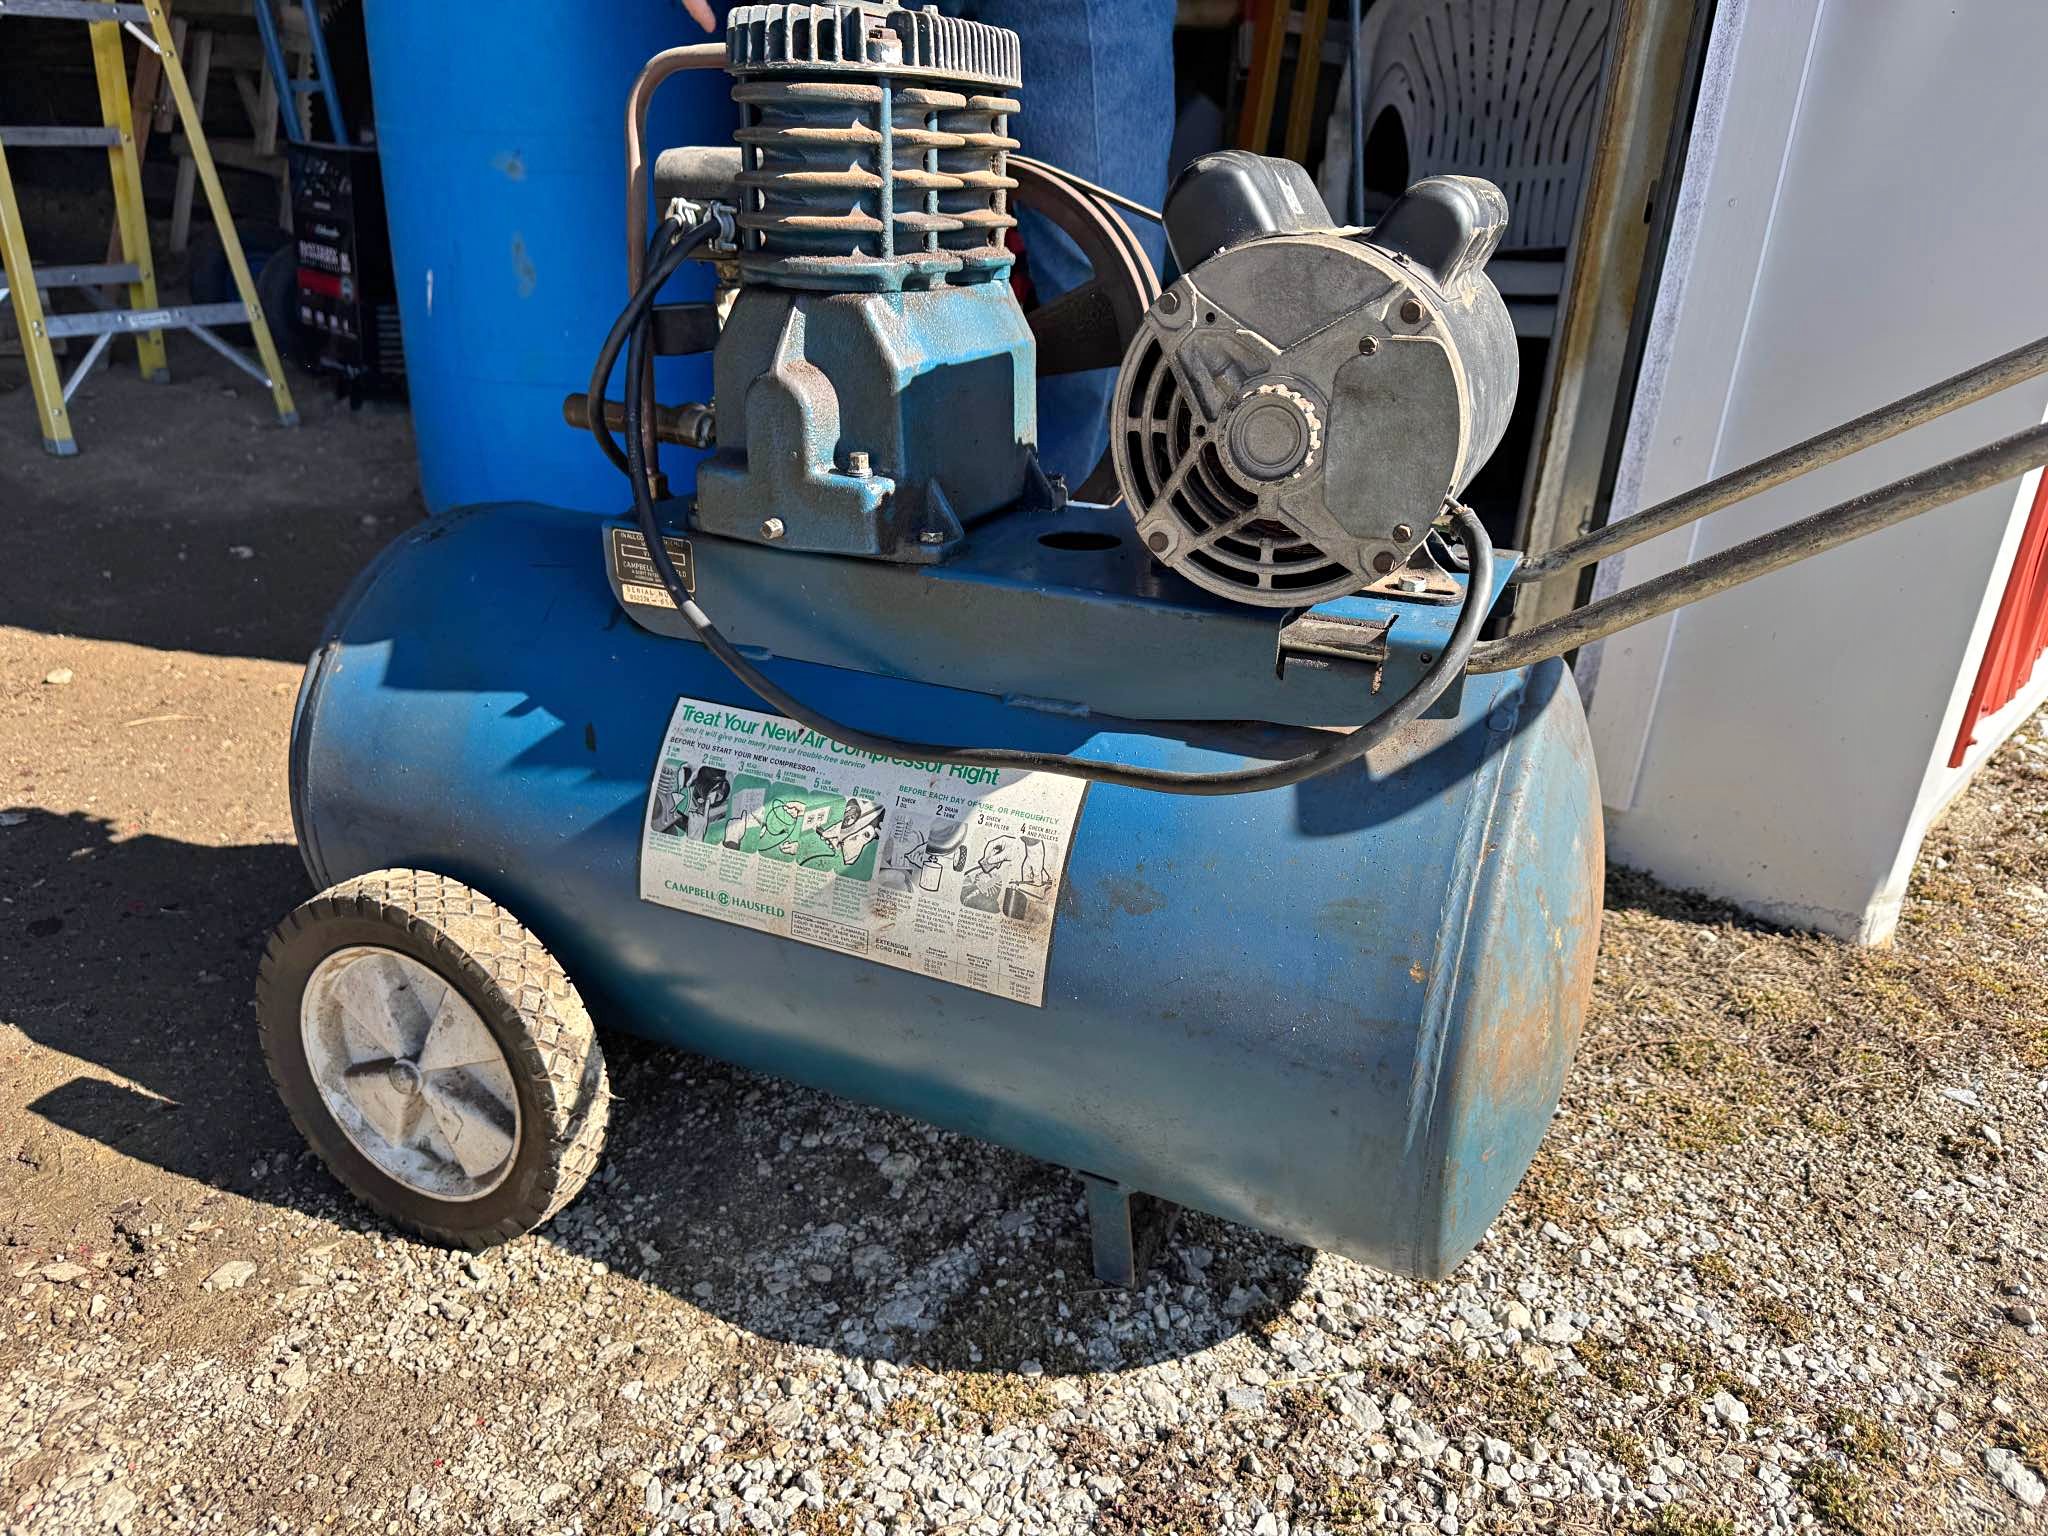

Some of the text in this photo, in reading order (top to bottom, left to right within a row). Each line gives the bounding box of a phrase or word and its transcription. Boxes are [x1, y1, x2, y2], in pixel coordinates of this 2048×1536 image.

[624, 560, 654, 573] CAMPBELL
[626, 585, 654, 596] SERIAL
[670, 736, 695, 747] BEFORE
[697, 742, 711, 750] YOU
[711, 745, 732, 755] START
[733, 750, 752, 760] YOUR
[752, 754, 769, 763] NEW
[683, 704, 721, 727] Treat
[724, 712, 759, 737] Your
[761, 720, 800, 744] New
[801, 729, 828, 749] Air
[949, 764, 1000, 786] Right
[704, 729, 717, 738] will
[718, 731, 733, 741] give
[734, 735, 747, 744] you
[747, 739, 767, 750] many
[767, 742, 787, 753] years
[788, 747, 796, 755] of
[797, 748, 840, 764] trouble-free
[840, 758, 866, 769] service
[702, 753, 709, 764] 2
[738, 760, 744, 772] 3
[775, 768, 782, 780] 4
[813, 777, 820, 788] 5
[820, 785, 840, 793] VOLTAGE
[852, 786, 860, 797] 6
[895, 795, 916, 807] 1 CHECK
[899, 785, 928, 797] BEFORE
[929, 791, 949, 801] EACH
[950, 796, 966, 805] DAY
[967, 800, 978, 808] OF
[998, 806, 1009, 815] OR
[1010, 810, 1060, 825] FREQUENTLY
[936, 804, 959, 816] 2 DRAIN
[943, 811, 955, 819] TANK
[977, 813, 1001, 825] 3 CHECK
[993, 823, 1009, 831] FILTER
[1020, 822, 1026, 834] 4
[1028, 824, 1044, 832] CHECK
[1027, 830, 1059, 842] AND PULLEYS
[664, 880, 716, 901] CAMPBELL
[732, 896, 785, 918] HAUSFELD
[875, 938, 909, 951] EXTENSION
[875, 944, 912, 959] CORD TABLE
